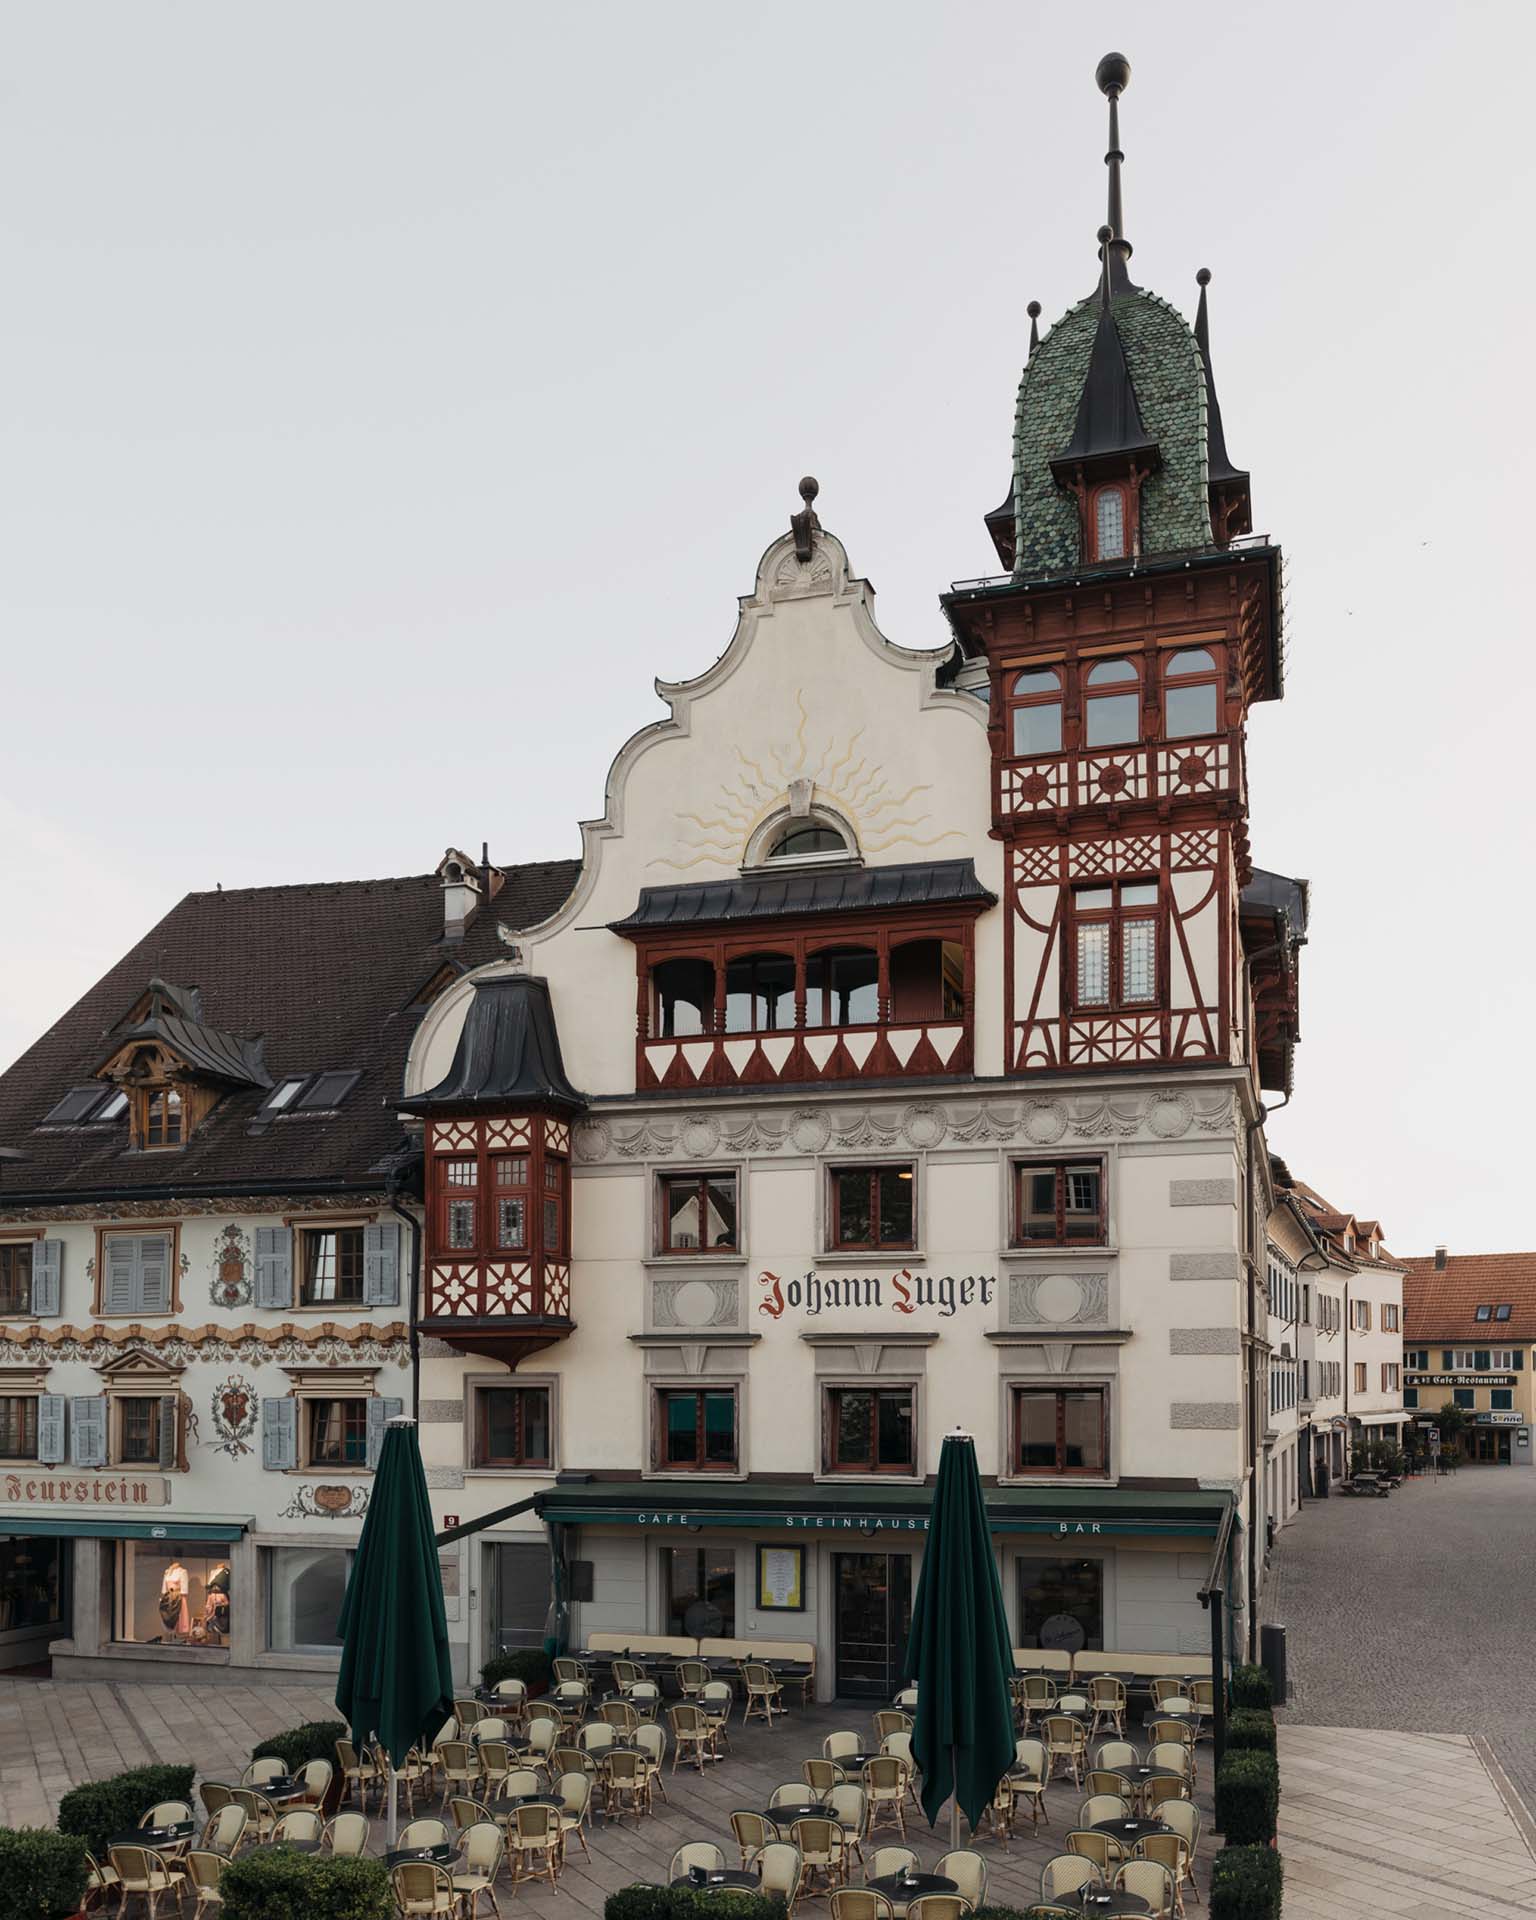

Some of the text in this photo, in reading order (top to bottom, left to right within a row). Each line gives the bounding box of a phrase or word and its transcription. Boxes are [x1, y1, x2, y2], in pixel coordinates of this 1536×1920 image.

[758, 1267, 997, 1319] Johann Luger
[5, 1474, 149, 1503] Feurstein
[448, 1516, 455, 1525] 9
[638, 1513, 688, 1525] CAFE
[1060, 1522, 1101, 1533] BAR
